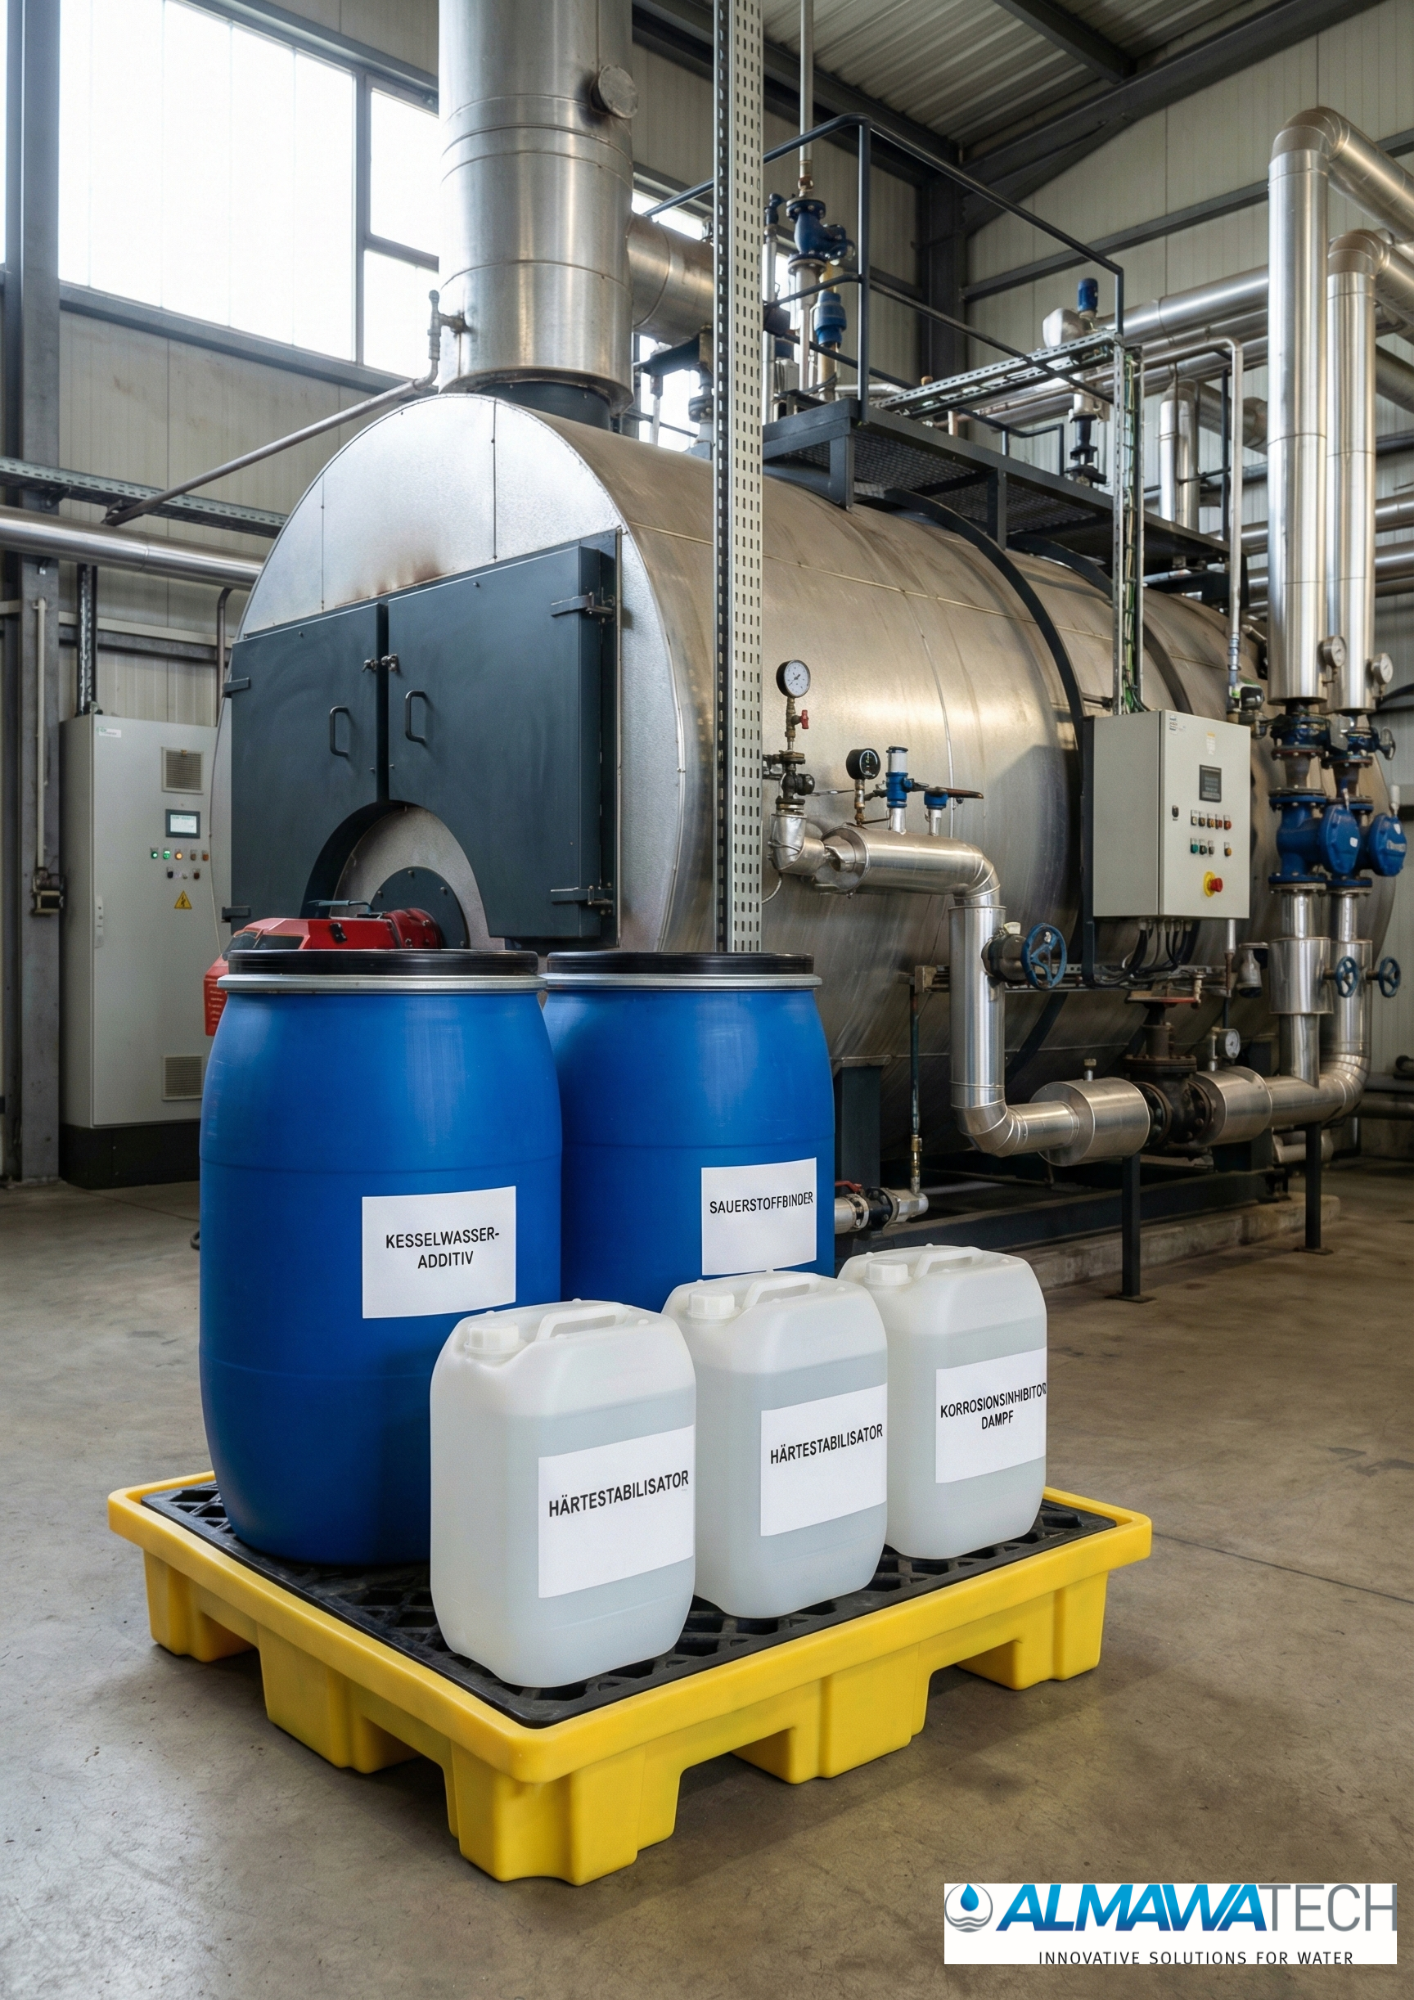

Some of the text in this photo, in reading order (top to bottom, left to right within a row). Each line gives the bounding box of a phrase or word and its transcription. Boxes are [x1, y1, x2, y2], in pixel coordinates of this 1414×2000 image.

[709, 1191, 814, 1214] SAUERSTOFFBINDER
[386, 1227, 501, 1249] KESSELWASSER-
[417, 1250, 474, 1269] ADDITIV
[981, 1410, 1014, 1430] DAMPF
[770, 1423, 883, 1464] HÄRTESTABILISATOR
[549, 1470, 689, 1518] HÄRTESTABILISATOR
